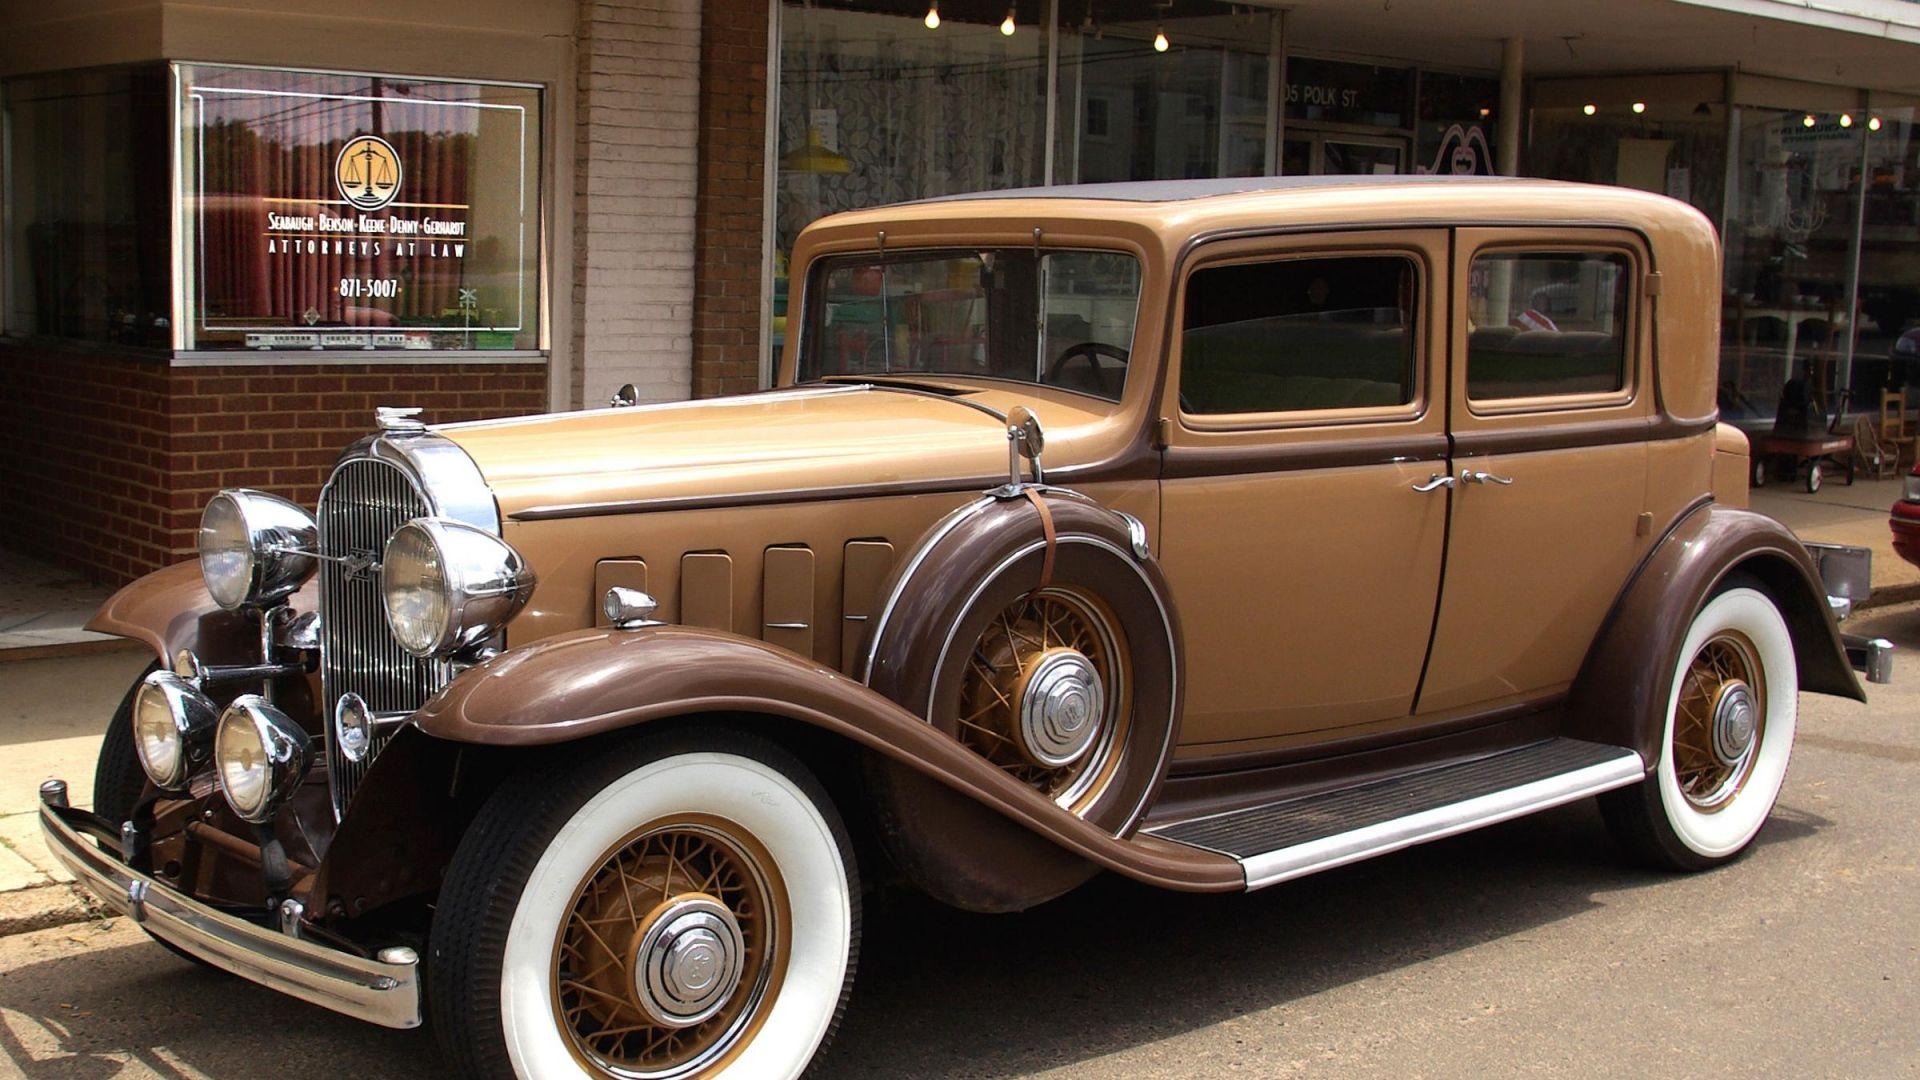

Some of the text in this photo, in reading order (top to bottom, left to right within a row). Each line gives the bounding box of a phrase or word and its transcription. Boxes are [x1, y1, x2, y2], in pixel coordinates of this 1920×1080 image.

[1304, 86, 1336, 105] POLK
[319, 213, 354, 231] BENSON
[359, 214, 386, 233] KEENE
[390, 215, 418, 234] DENNY
[268, 239, 464, 257] ATTORNEYS AT LAW
[340, 278, 397, 298] 871-5007
